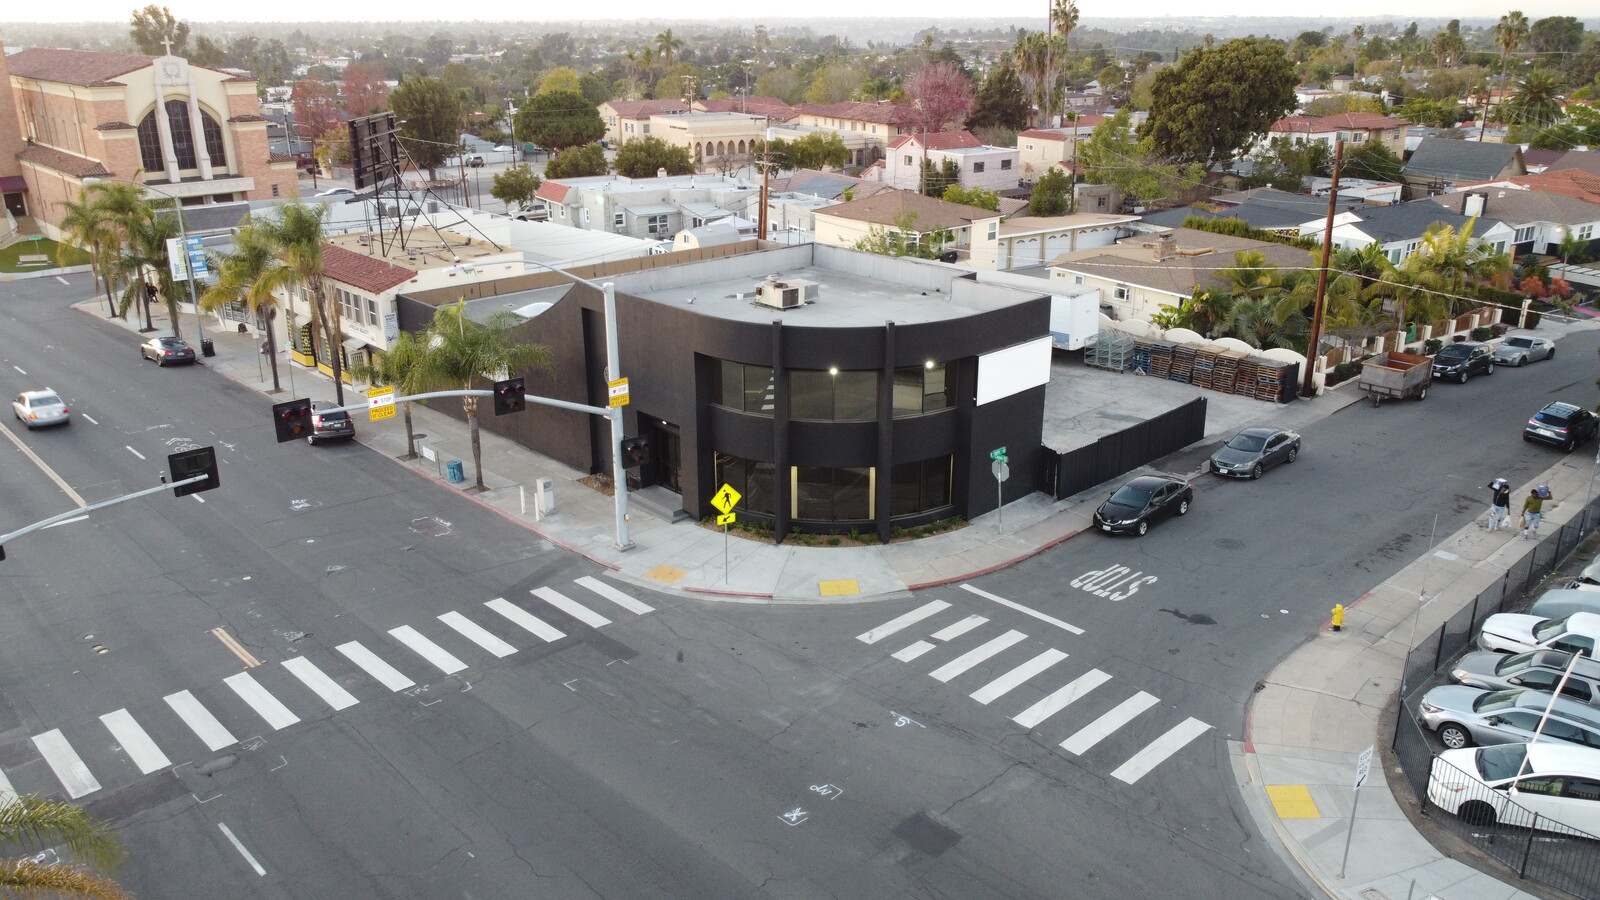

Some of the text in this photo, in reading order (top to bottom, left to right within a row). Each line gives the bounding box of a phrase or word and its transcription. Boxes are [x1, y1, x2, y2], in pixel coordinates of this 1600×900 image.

[371, 405, 393, 413] PROCEED
[378, 410, 393, 418] CLEAR
[1070, 564, 1158, 601] STOP
[1359, 750, 1371, 763] STOP
